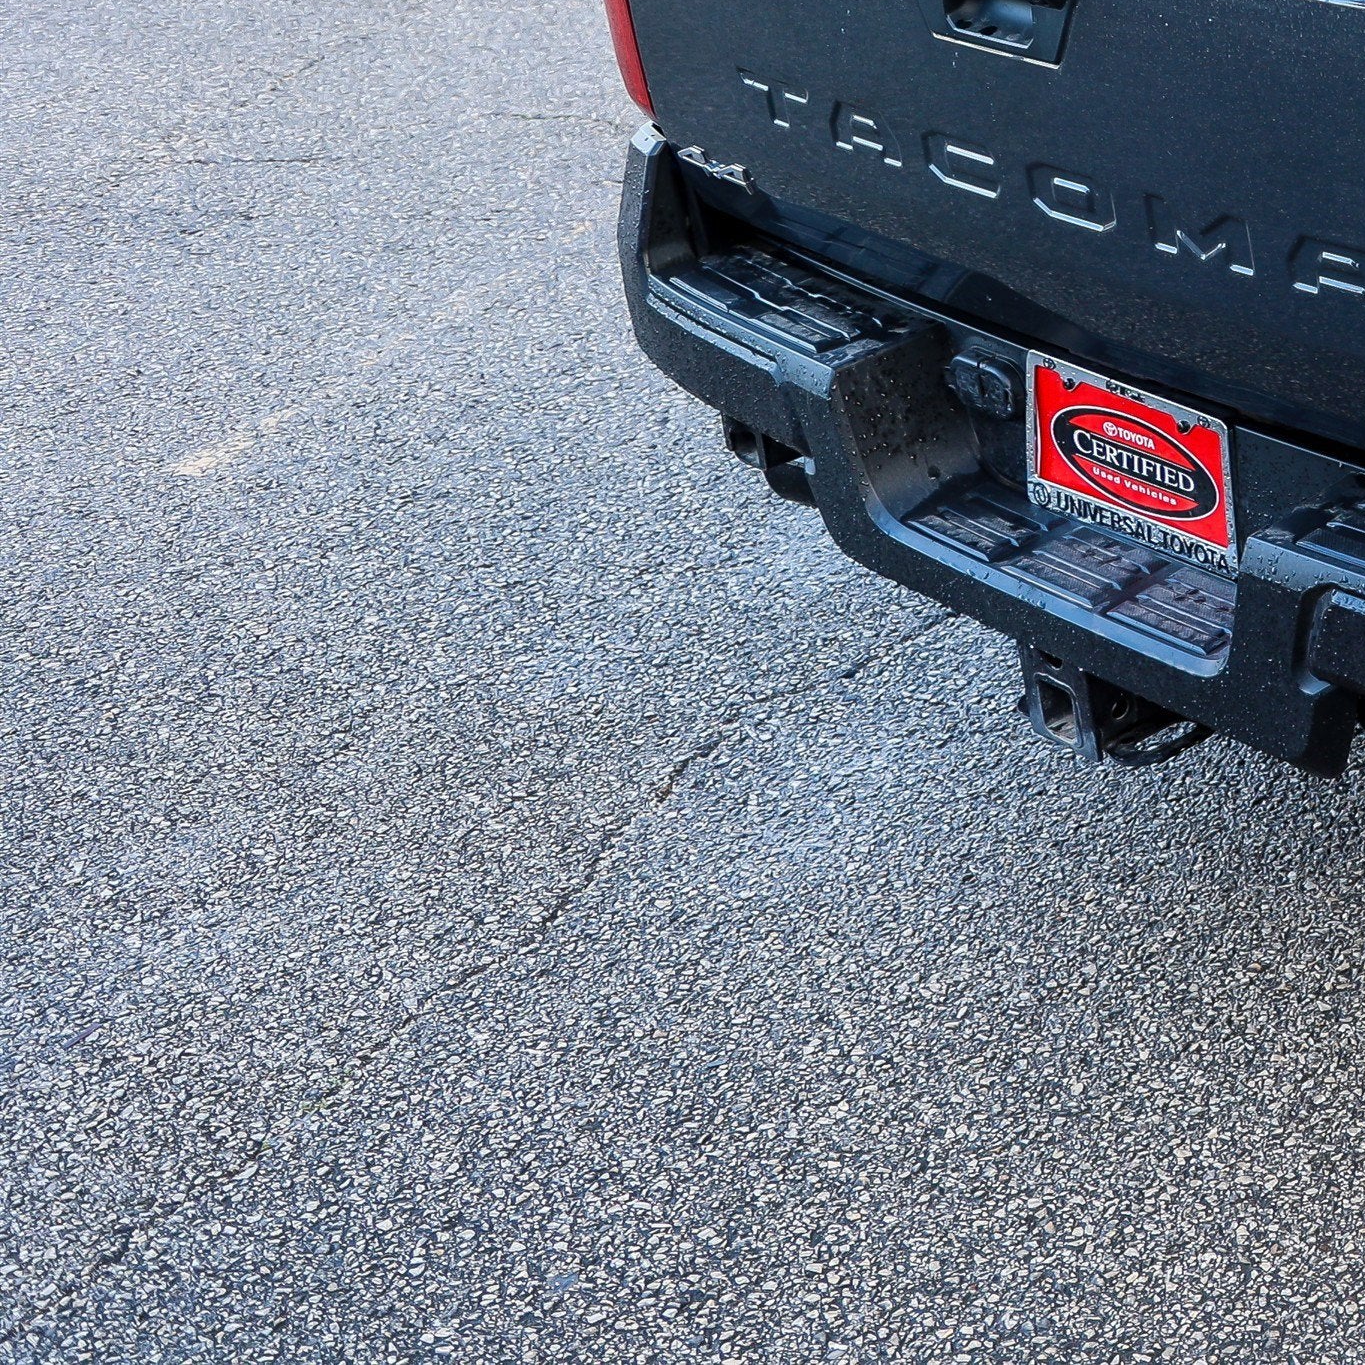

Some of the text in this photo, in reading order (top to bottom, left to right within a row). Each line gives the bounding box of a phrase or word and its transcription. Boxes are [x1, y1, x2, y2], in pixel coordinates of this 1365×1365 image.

[1117, 426, 1156, 451] TOYOTA
[1092, 466, 1178, 506] Used Vehicles
[1055, 489, 1230, 574] UNIVERSAL TOYOTA
